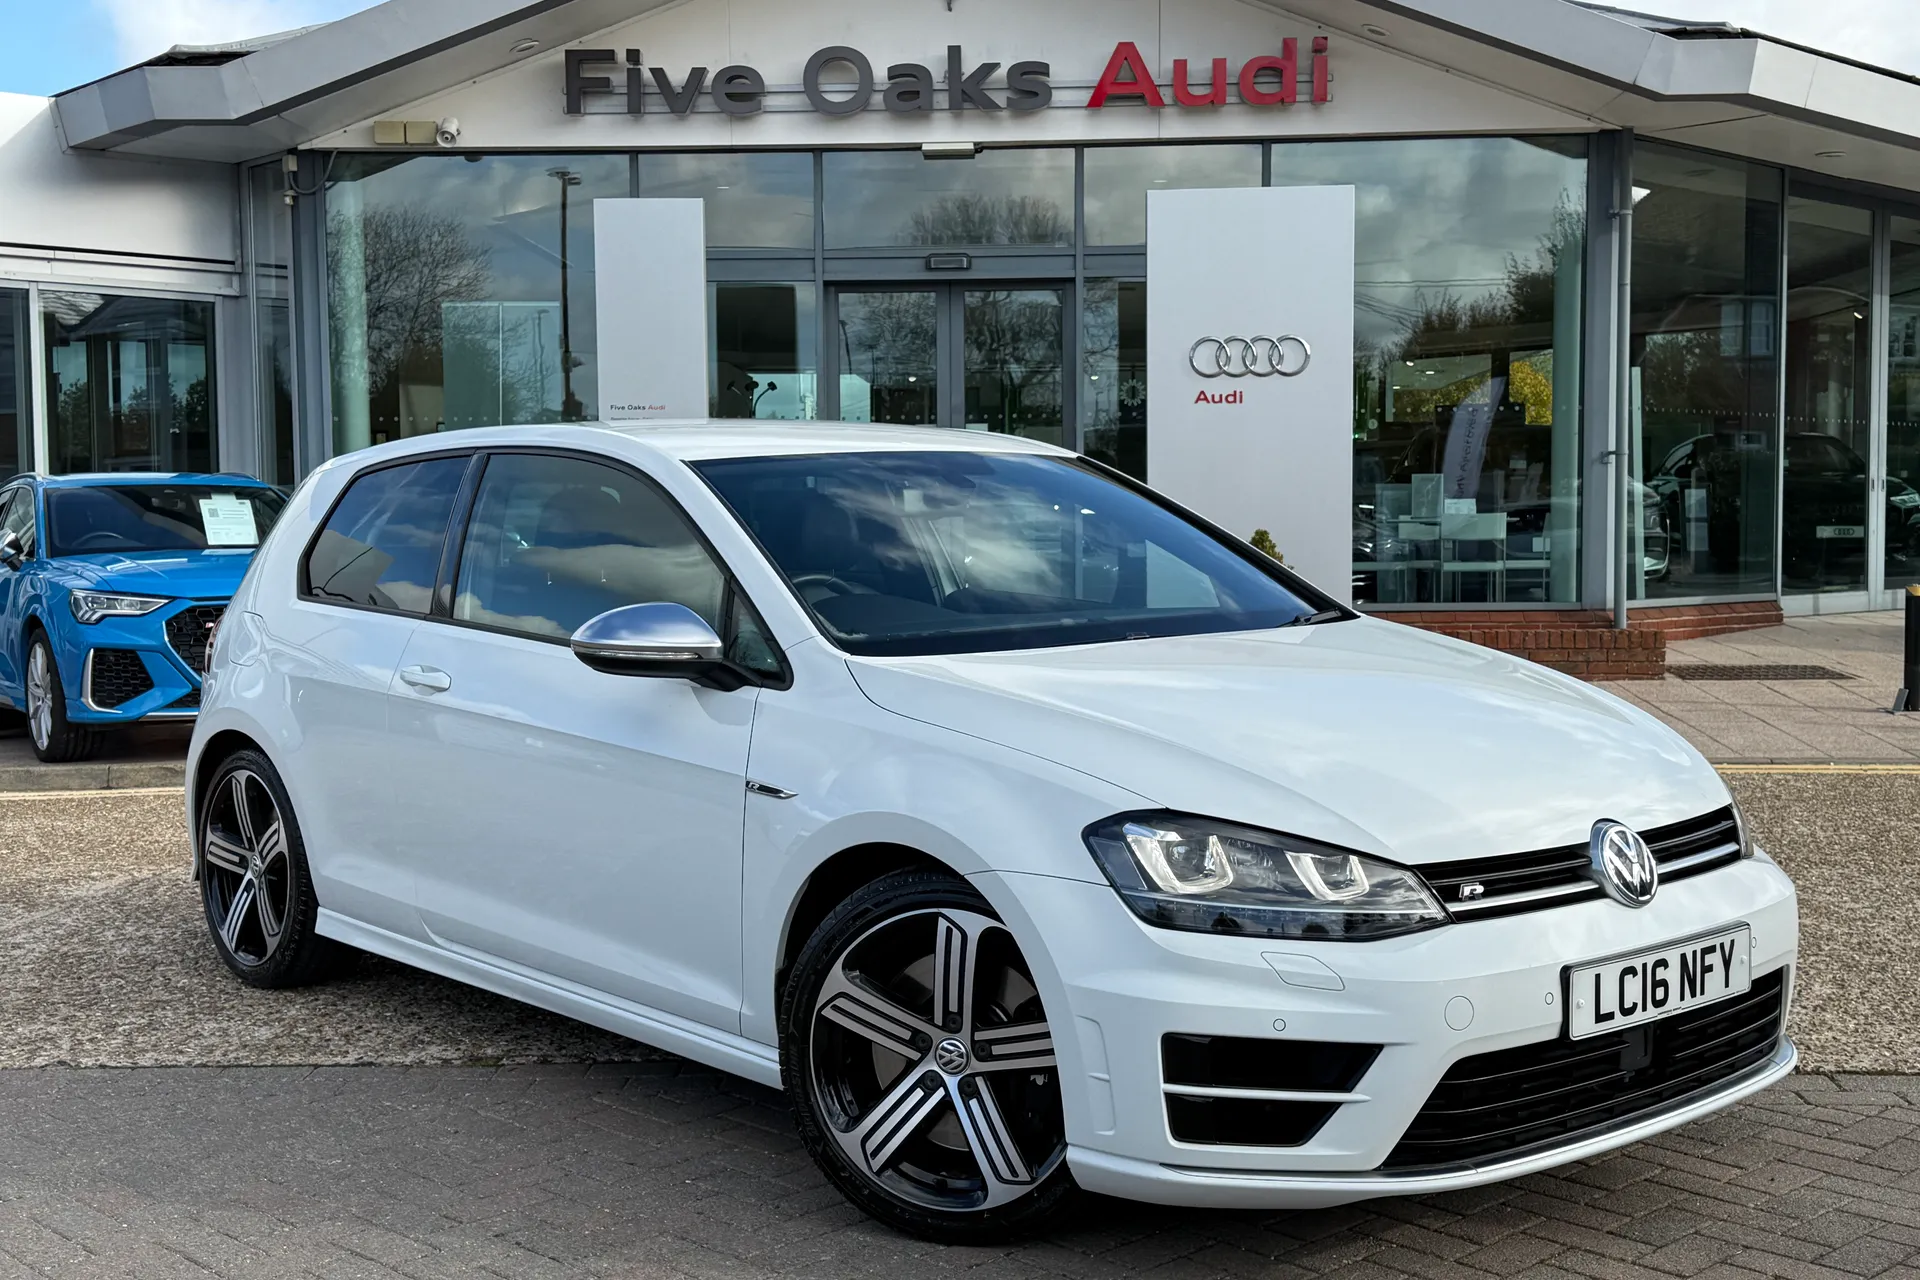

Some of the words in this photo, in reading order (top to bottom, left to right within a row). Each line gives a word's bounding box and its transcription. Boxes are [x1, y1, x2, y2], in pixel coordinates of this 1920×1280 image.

[564, 48, 766, 116] Five
[803, 44, 1053, 116] Oaks
[1086, 36, 1329, 109] Audi
[1194, 389, 1244, 404] Audi
[747, 781, 760, 791] R
[1459, 882, 1485, 901] R
[1594, 957, 1670, 1024] LC16
[1679, 938, 1735, 1003] NFY
